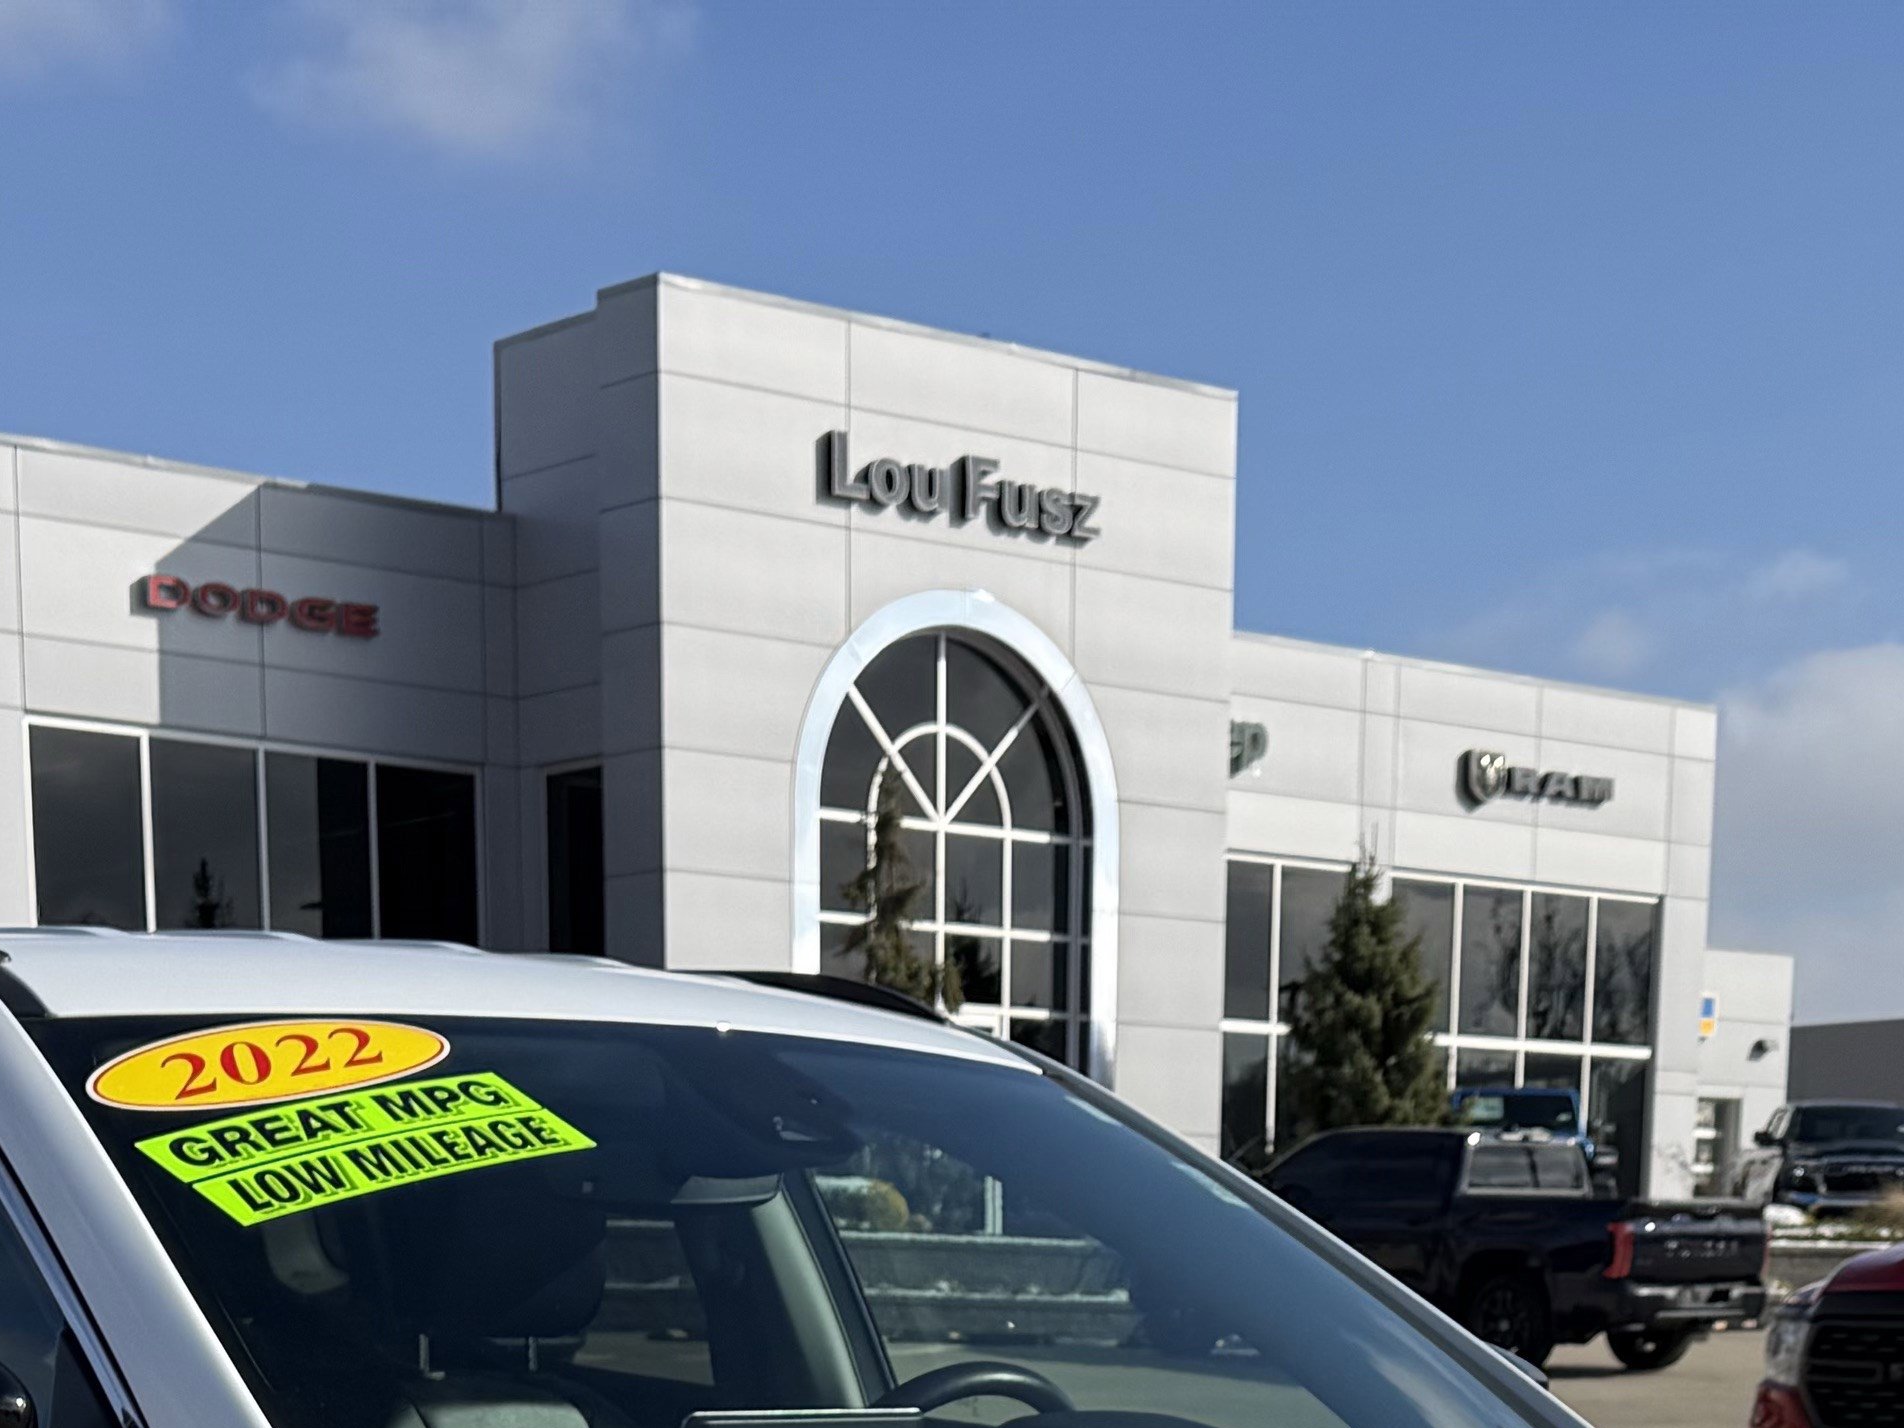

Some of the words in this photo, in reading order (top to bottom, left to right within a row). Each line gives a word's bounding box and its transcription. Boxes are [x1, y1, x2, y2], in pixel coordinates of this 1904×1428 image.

[815, 430, 948, 514] Lou
[949, 455, 1101, 541] Fusz
[145, 574, 380, 638] DODGE
[1507, 766, 1615, 808] RAM
[160, 1026, 385, 1101] 2022
[168, 1099, 368, 1171] GREAT
[380, 1080, 516, 1125] MPG
[228, 1158, 354, 1214] LOW
[348, 1114, 568, 1184] MILEAGE
